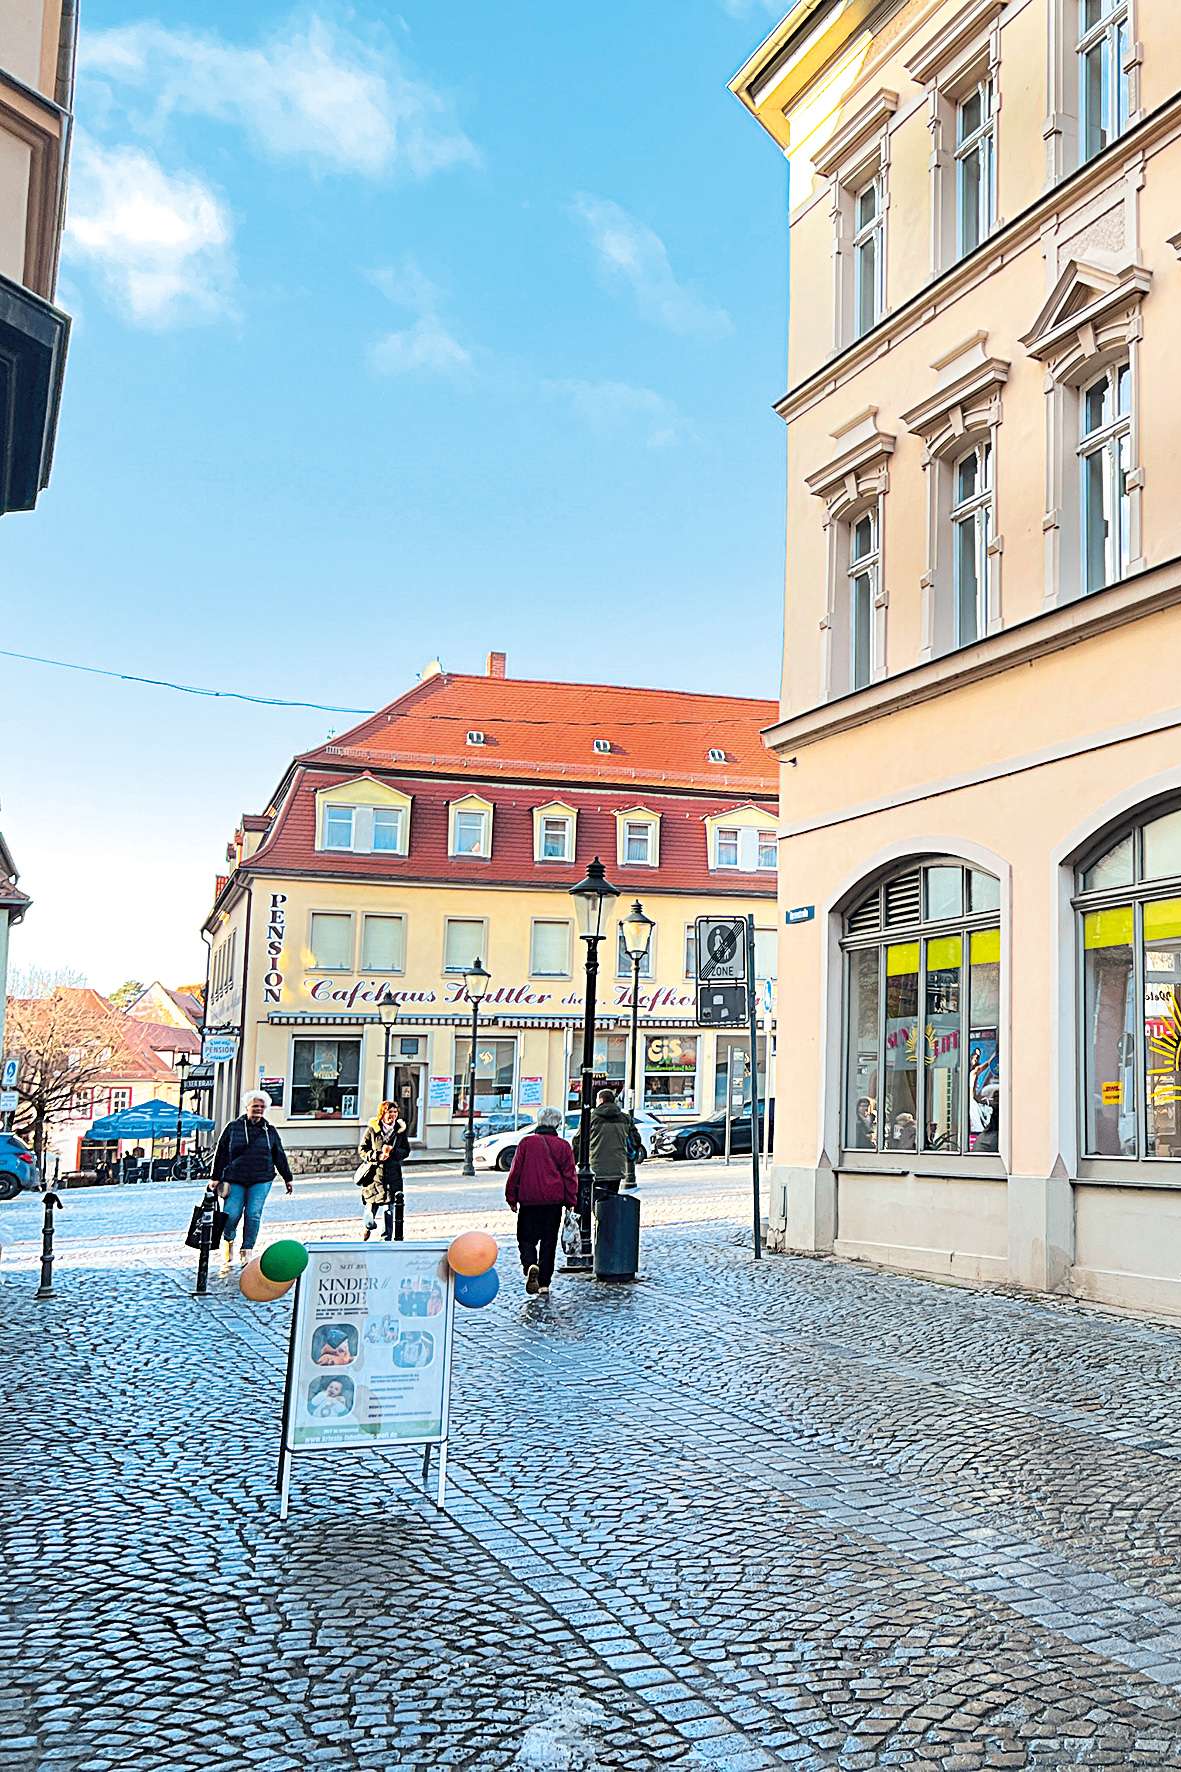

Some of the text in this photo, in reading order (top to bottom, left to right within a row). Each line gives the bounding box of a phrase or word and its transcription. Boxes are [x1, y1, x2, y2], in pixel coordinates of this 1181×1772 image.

[263, 893, 287, 1003] PENSION
[711, 966, 734, 976] ZONE
[317, 1276, 380, 1292] KINDER
[317, 1291, 367, 1307] MODE
